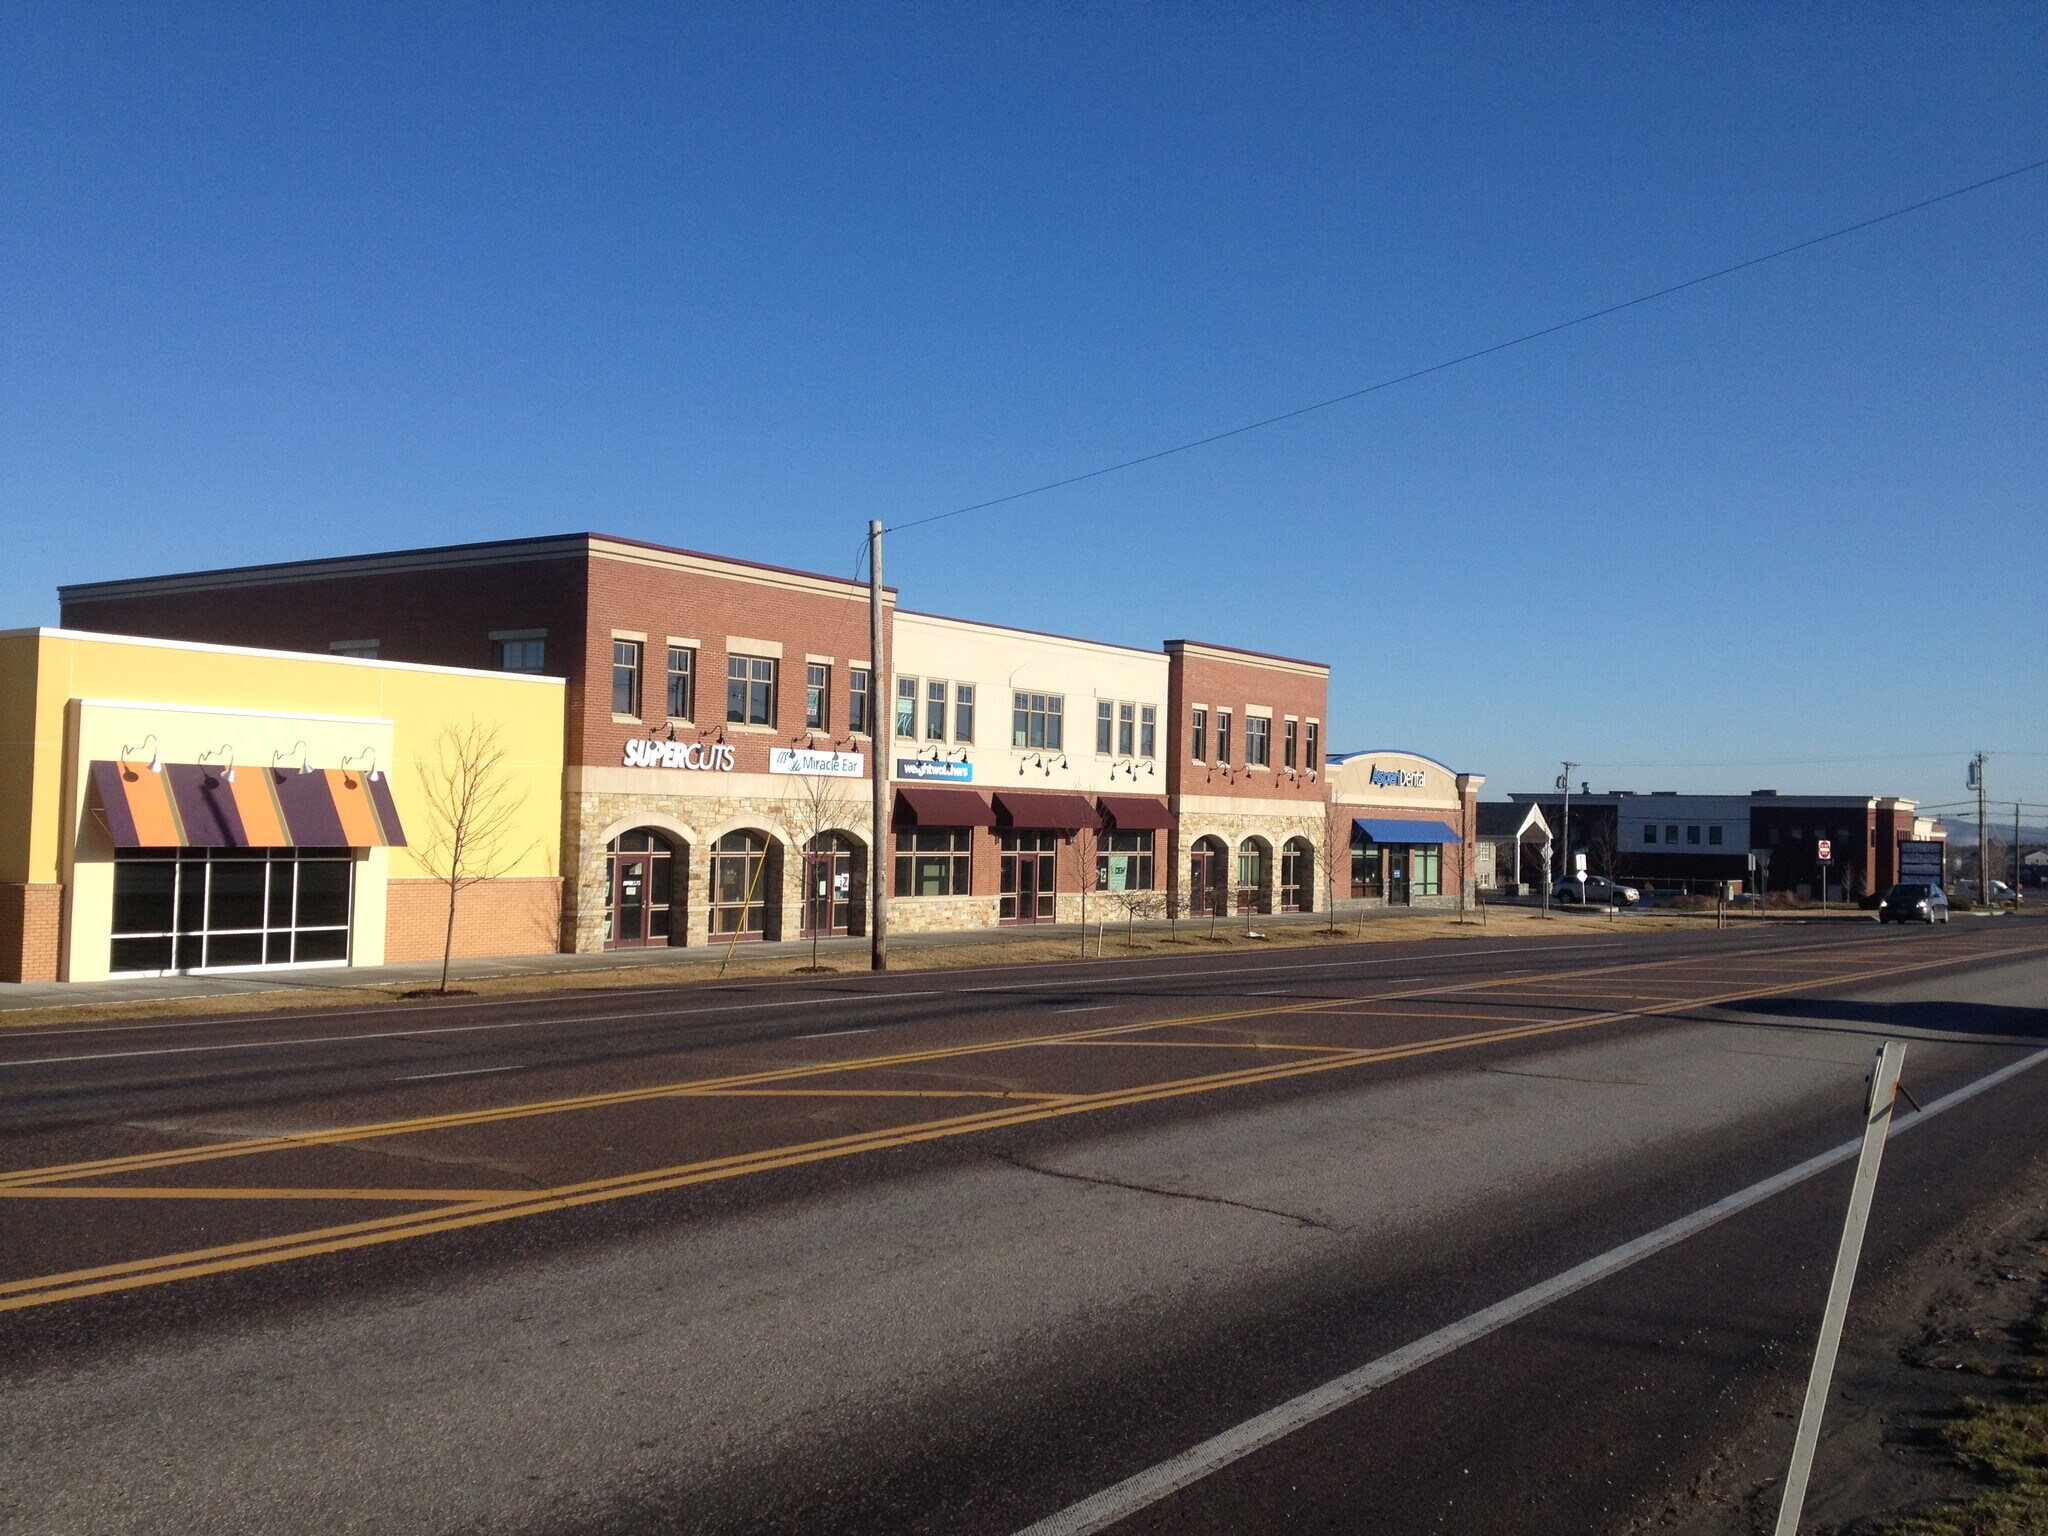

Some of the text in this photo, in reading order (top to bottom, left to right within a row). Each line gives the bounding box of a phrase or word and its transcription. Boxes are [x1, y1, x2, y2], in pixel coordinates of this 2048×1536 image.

[623, 738, 736, 772] SUPERCUTS
[803, 756, 858, 772] Miracle Ear
